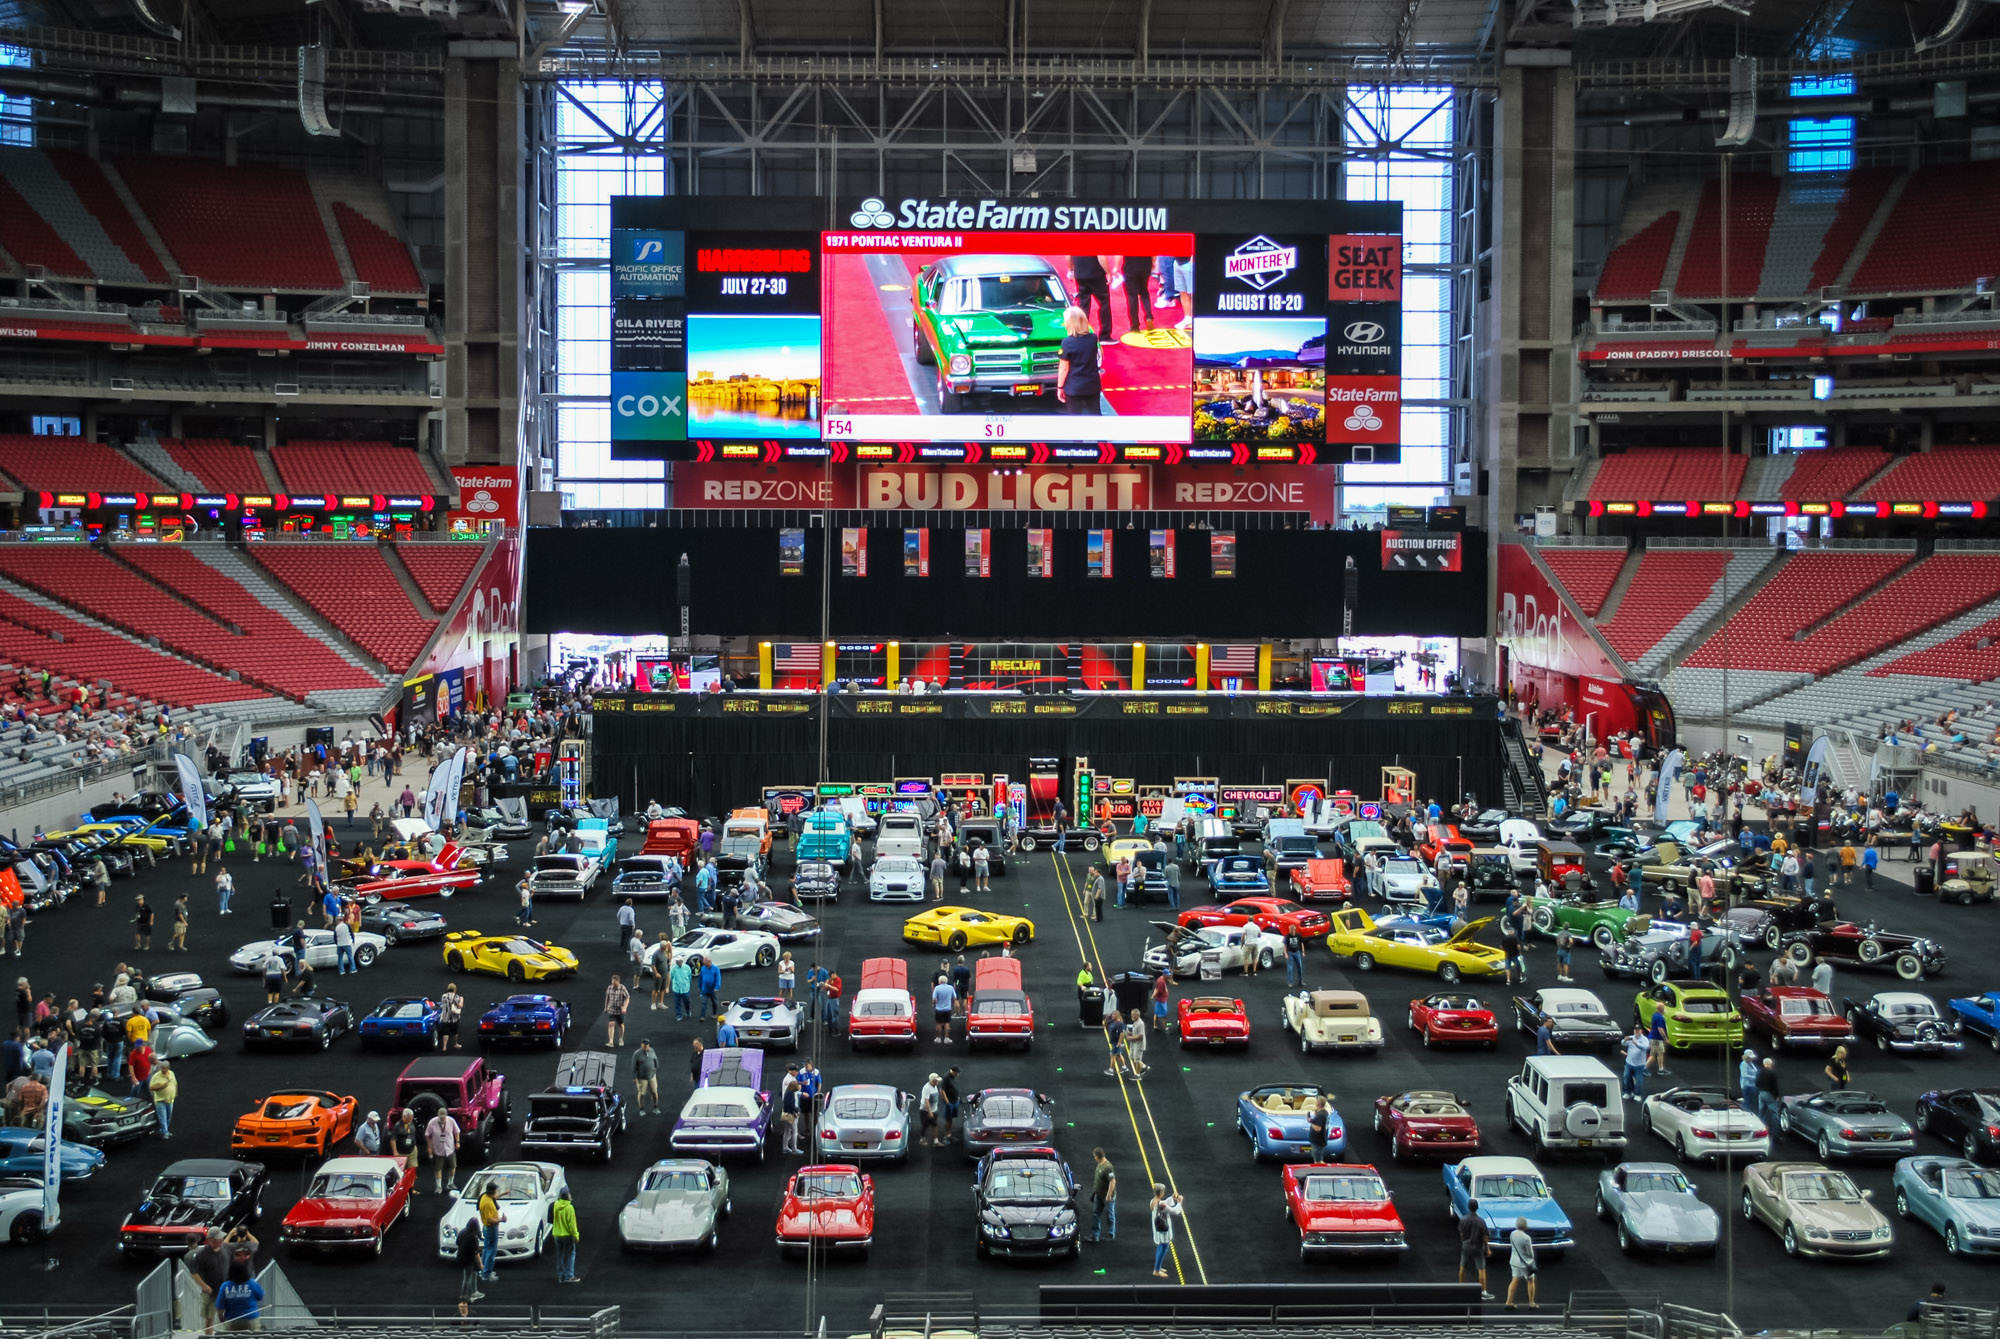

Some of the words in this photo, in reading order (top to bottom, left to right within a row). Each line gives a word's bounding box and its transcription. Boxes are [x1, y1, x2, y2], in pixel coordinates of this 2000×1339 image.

[1054, 207, 1166, 231] STADIUM
[826, 236, 849, 247] 1971
[851, 236, 899, 247] PONTIAC
[901, 236, 953, 247] VENTURA
[954, 236, 962, 247] II
[697, 249, 811, 273] HARRISBURG
[1229, 252, 1290, 273] MONTEREY
[1338, 246, 1392, 266] SEAT
[615, 265, 648, 273] PACIFIC
[651, 265, 682, 273] OFFICE
[619, 273, 678, 281] AUTOMATION
[1335, 269, 1394, 290] GEEK
[721, 278, 749, 294] JULY
[751, 278, 787, 294] 27-30
[1218, 294, 1265, 311] AUGUST
[1268, 294, 1302, 311] 18-20
[615, 319, 643, 328] GILA
[645, 319, 682, 328] RIVER
[0, 328, 37, 337] WILSON
[305, 342, 338, 350] JIMMY
[341, 342, 405, 351] CONZELMAN
[1337, 346, 1391, 355] HYUNDAI
[1606, 351, 1633, 359] JOHN
[1636, 350, 1679, 359] (PADDY)
[1682, 350, 1732, 358] DRISCOLL
[617, 395, 681, 417] COX
[985, 416, 1013, 424] ASKING
[828, 420, 852, 435] F54
[868, 472, 978, 510] BUD
[987, 472, 1141, 510] LIGHT
[1386, 539, 1425, 549] AUCTION
[1426, 539, 1457, 550] OFFICE
[990, 660, 1041, 671] MECUM
[451, 775, 459, 801] VETTES
[1662, 776, 1670, 802] VETTES
[1223, 790, 1281, 800] CHEVROLET
[1299, 790, 1316, 807] 76
[1095, 804, 1132, 814] LIUOR
